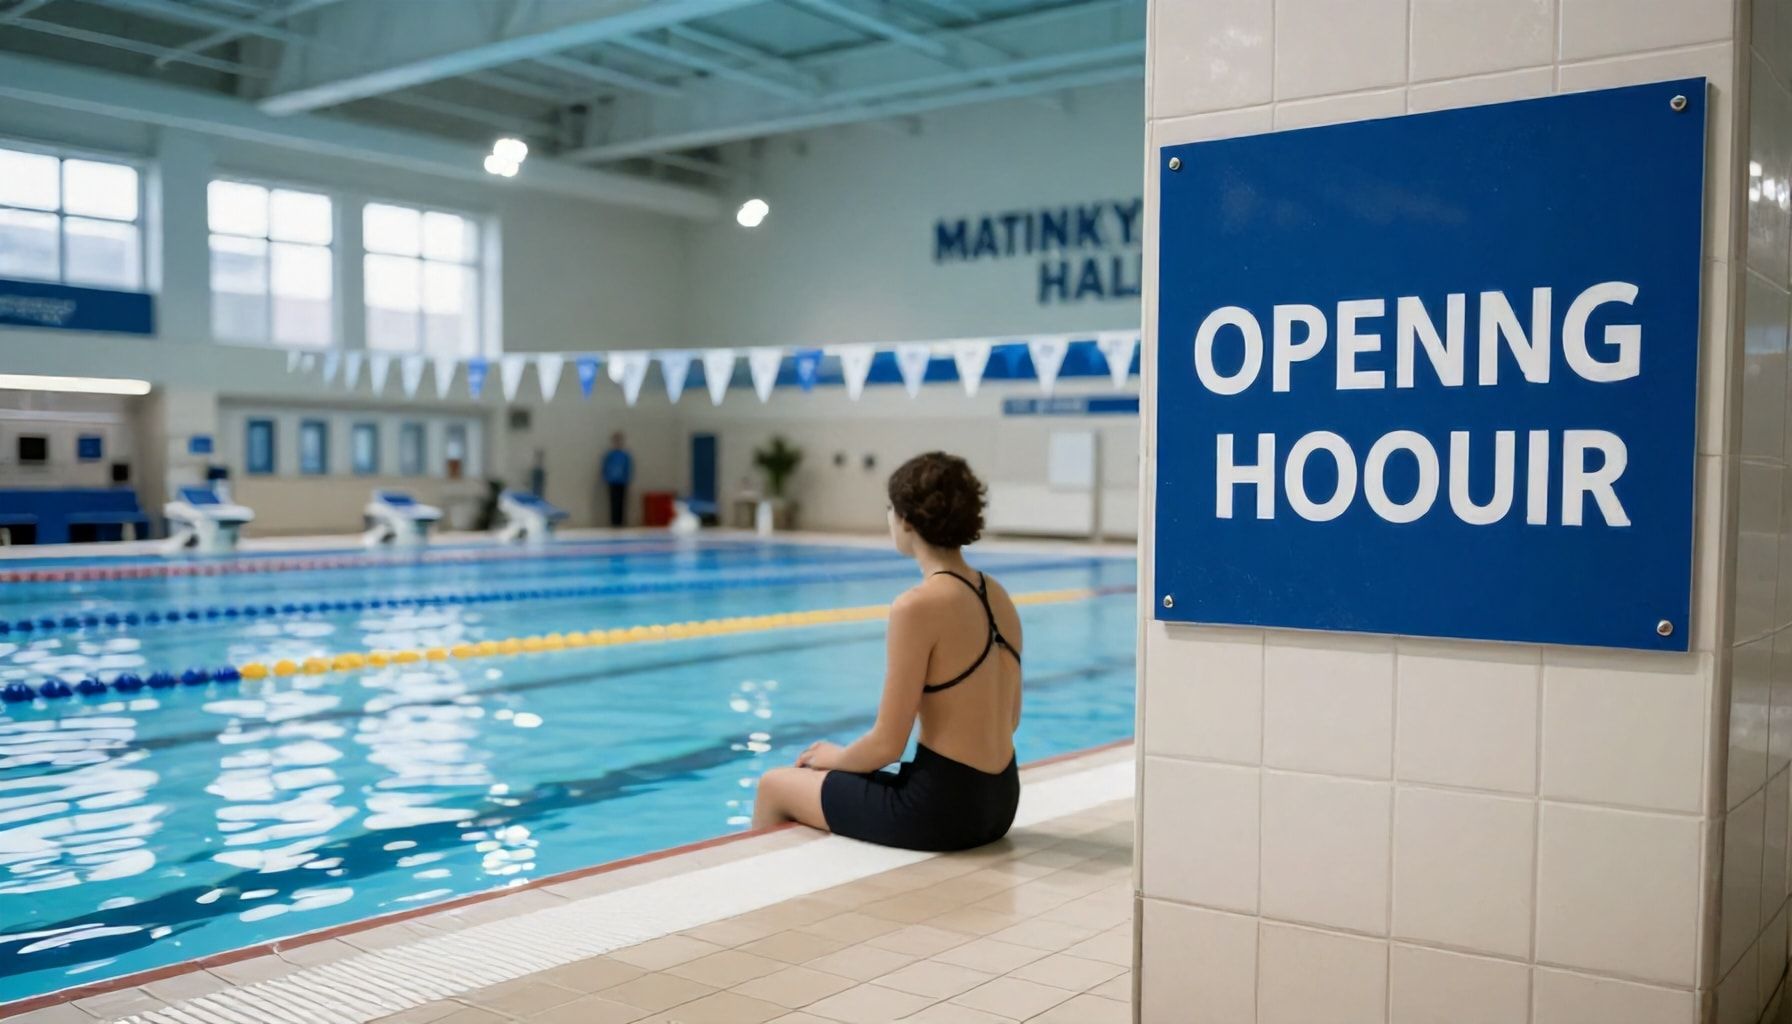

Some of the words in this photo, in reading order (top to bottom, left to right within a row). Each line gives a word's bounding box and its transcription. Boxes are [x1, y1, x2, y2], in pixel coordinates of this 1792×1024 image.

[1038, 256, 1142, 304] HAL
[1194, 281, 1642, 395] OPENNG
[1216, 429, 1631, 527] HOOUIR
